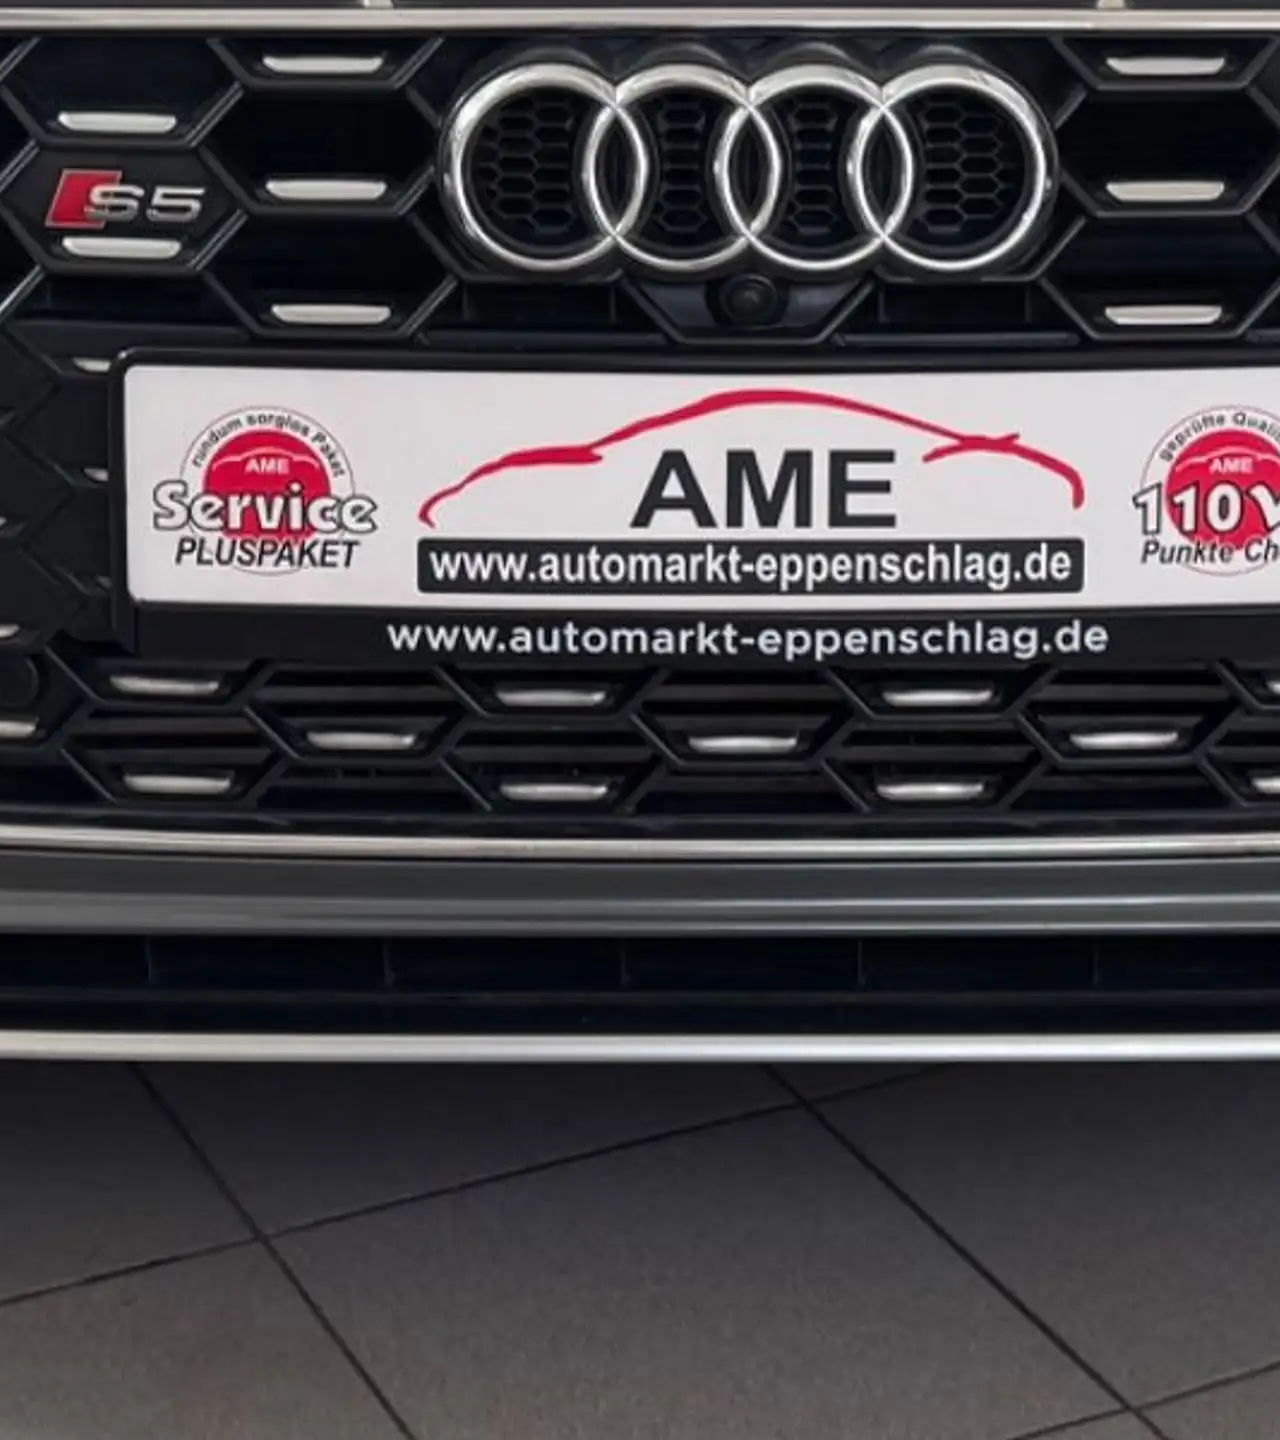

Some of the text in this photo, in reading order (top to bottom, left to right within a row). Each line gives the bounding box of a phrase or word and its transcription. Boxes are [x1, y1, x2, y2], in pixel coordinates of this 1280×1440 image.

[83, 184, 206, 222] S5
[191, 412, 346, 478] rundum sorglos Paket
[1159, 414, 1226, 463] geprüfte
[244, 458, 290, 475] AME
[1209, 458, 1255, 474] AME
[152, 479, 378, 535] Service
[630, 448, 898, 530] AME
[174, 536, 361, 568] PLUSPAKET
[429, 544, 1073, 592] www.automarkt-eppenschlag.de
[1140, 538, 1235, 565] Punkte
[387, 620, 1109, 662] www.automarkt-eppenschlag.de
